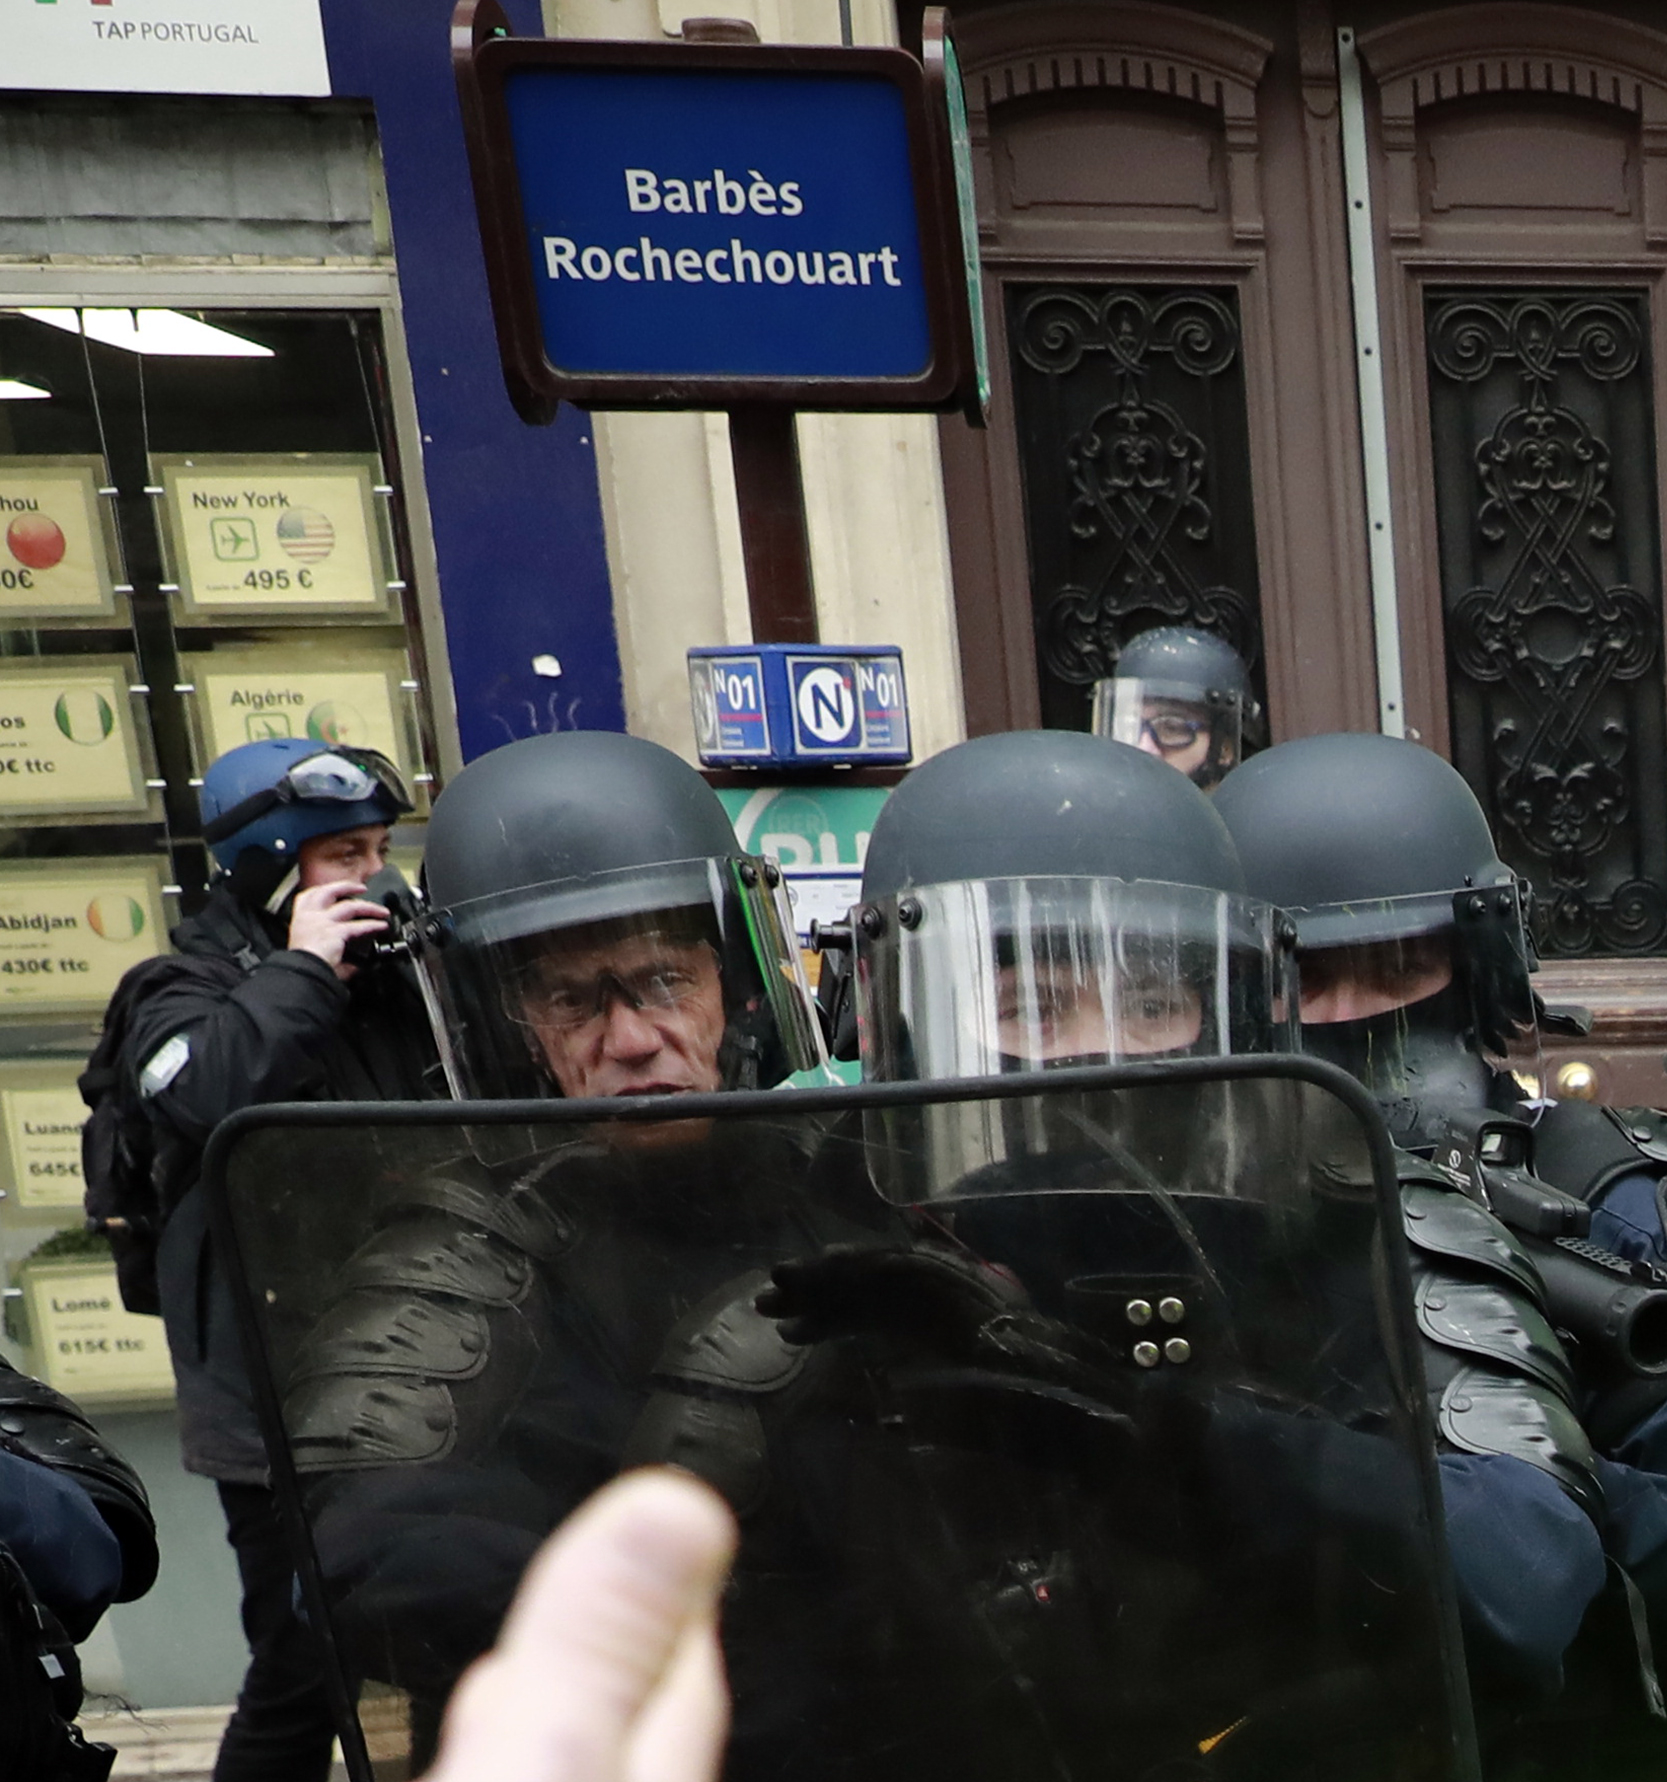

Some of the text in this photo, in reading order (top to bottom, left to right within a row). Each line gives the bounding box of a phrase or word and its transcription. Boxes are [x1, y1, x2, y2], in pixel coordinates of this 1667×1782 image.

[92, 20, 259, 44] TAP PORTUGAL
[625, 169, 803, 216] Barbès
[543, 236, 902, 286] Rochechouart
[193, 491, 290, 509] New York
[244, 570, 314, 589] 495 €
[230, 690, 305, 708] Algérie
